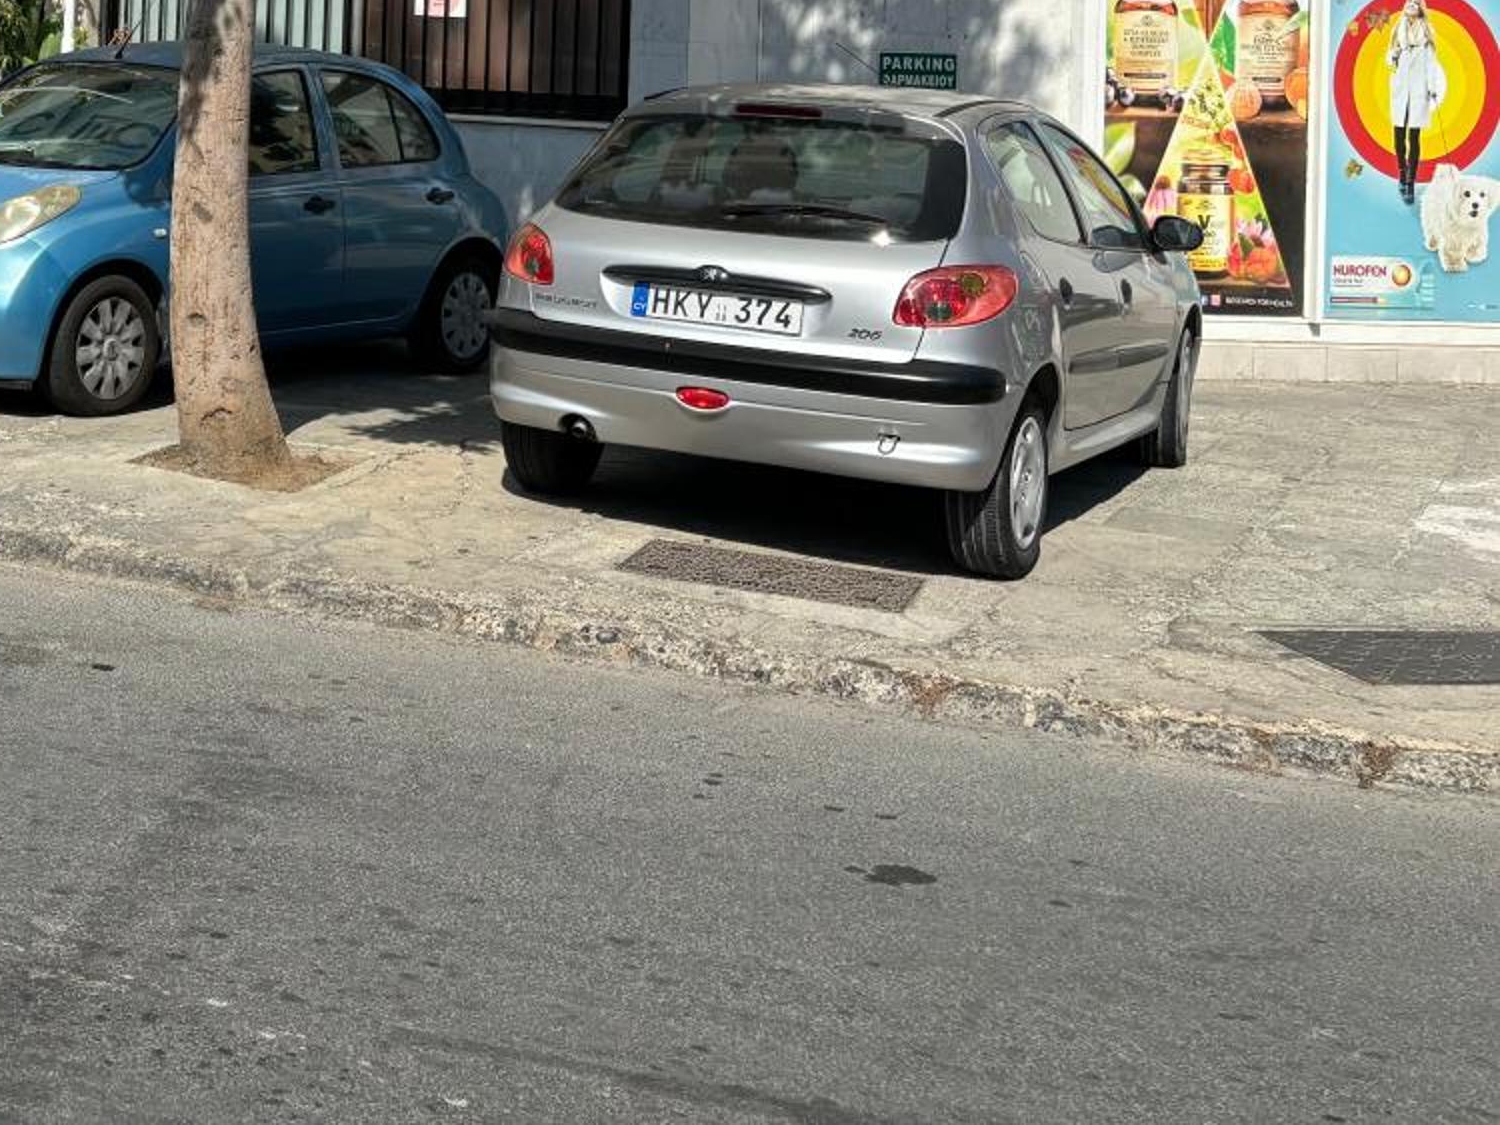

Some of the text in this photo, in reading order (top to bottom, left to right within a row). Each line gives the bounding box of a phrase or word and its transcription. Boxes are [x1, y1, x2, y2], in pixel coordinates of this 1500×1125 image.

[883, 56, 955, 72] PARKING
[1333, 264, 1387, 278] NUROFEN
[633, 302, 647, 312] CY
[652, 286, 792, 328] HKY 374
[848, 327, 883, 341] 206
